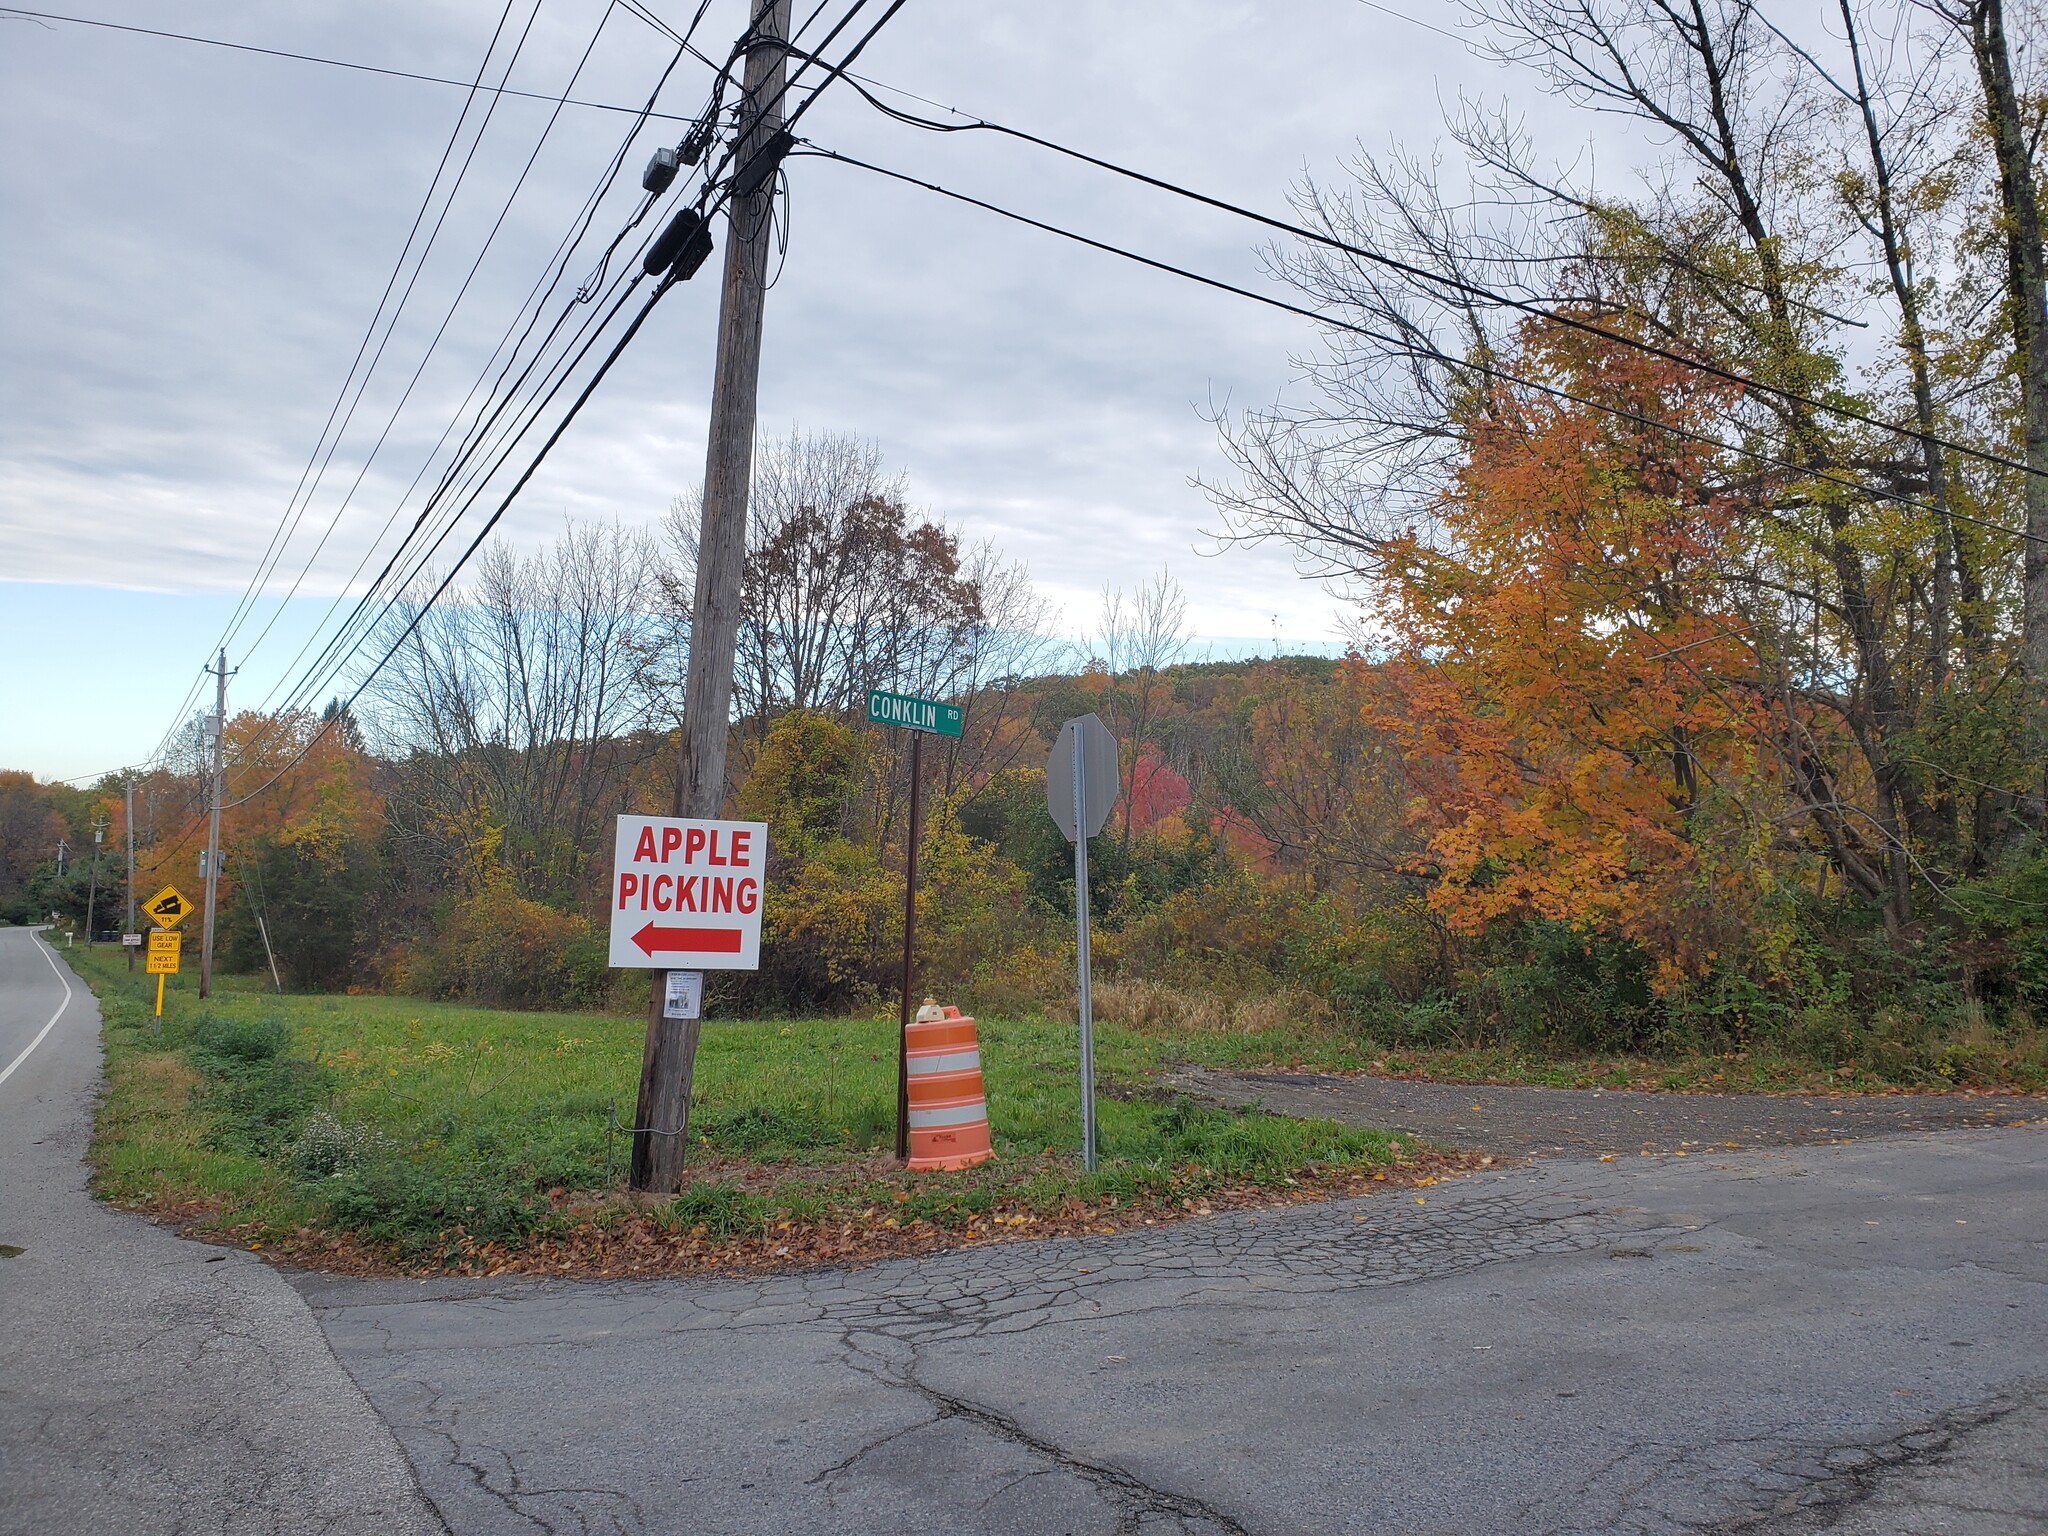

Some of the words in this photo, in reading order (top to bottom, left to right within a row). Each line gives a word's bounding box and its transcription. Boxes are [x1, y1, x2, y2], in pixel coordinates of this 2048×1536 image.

[871, 694, 936, 728] CONKLIN
[947, 709, 959, 720] RD
[633, 826, 751, 867] APPLE
[619, 873, 757, 914] PICKING
